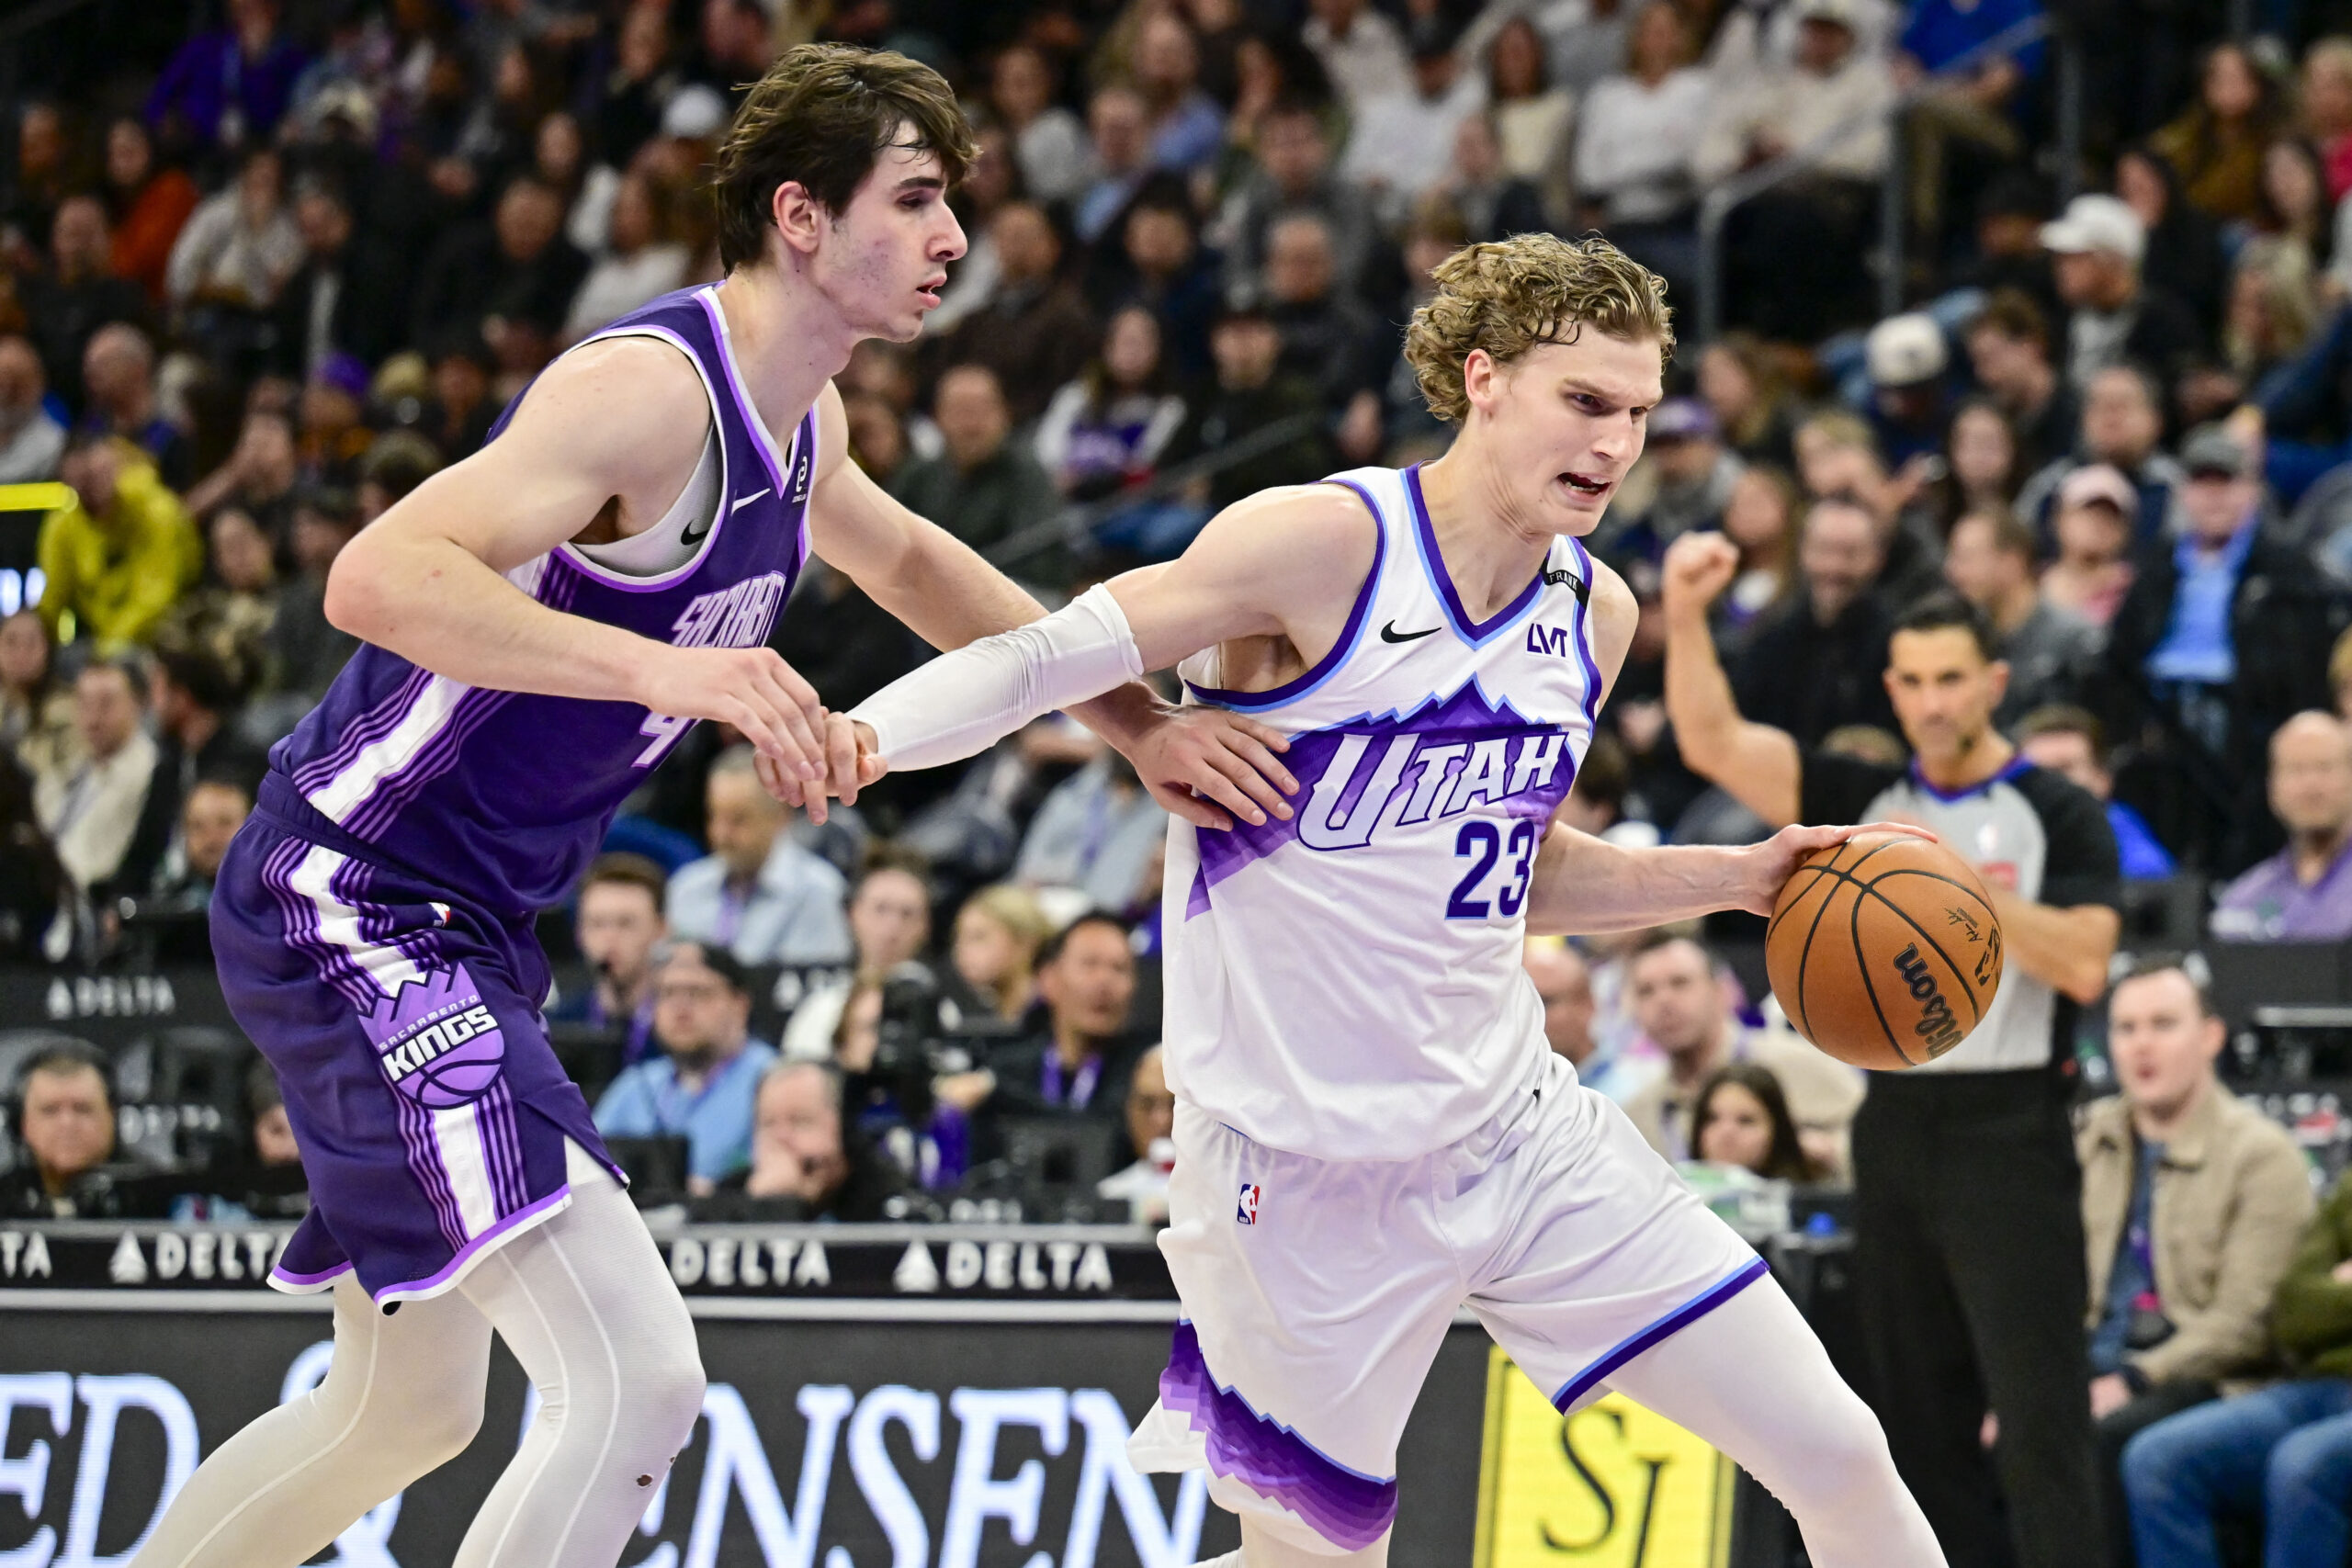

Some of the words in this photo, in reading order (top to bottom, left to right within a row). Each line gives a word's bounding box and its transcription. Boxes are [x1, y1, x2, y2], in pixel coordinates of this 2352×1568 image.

[1549, 570, 1578, 591] FRANK
[1527, 623, 1567, 658] LVT
[1295, 731, 1569, 852] UTAH
[1444, 817, 1536, 920] 23
[378, 994, 479, 1052] SACRAMENTO
[1894, 942, 1963, 1060] Wilson
[382, 1004, 499, 1082] KINGS
[670, 1238, 831, 1287] DELTA
[944, 1240, 1114, 1291] DELTA
